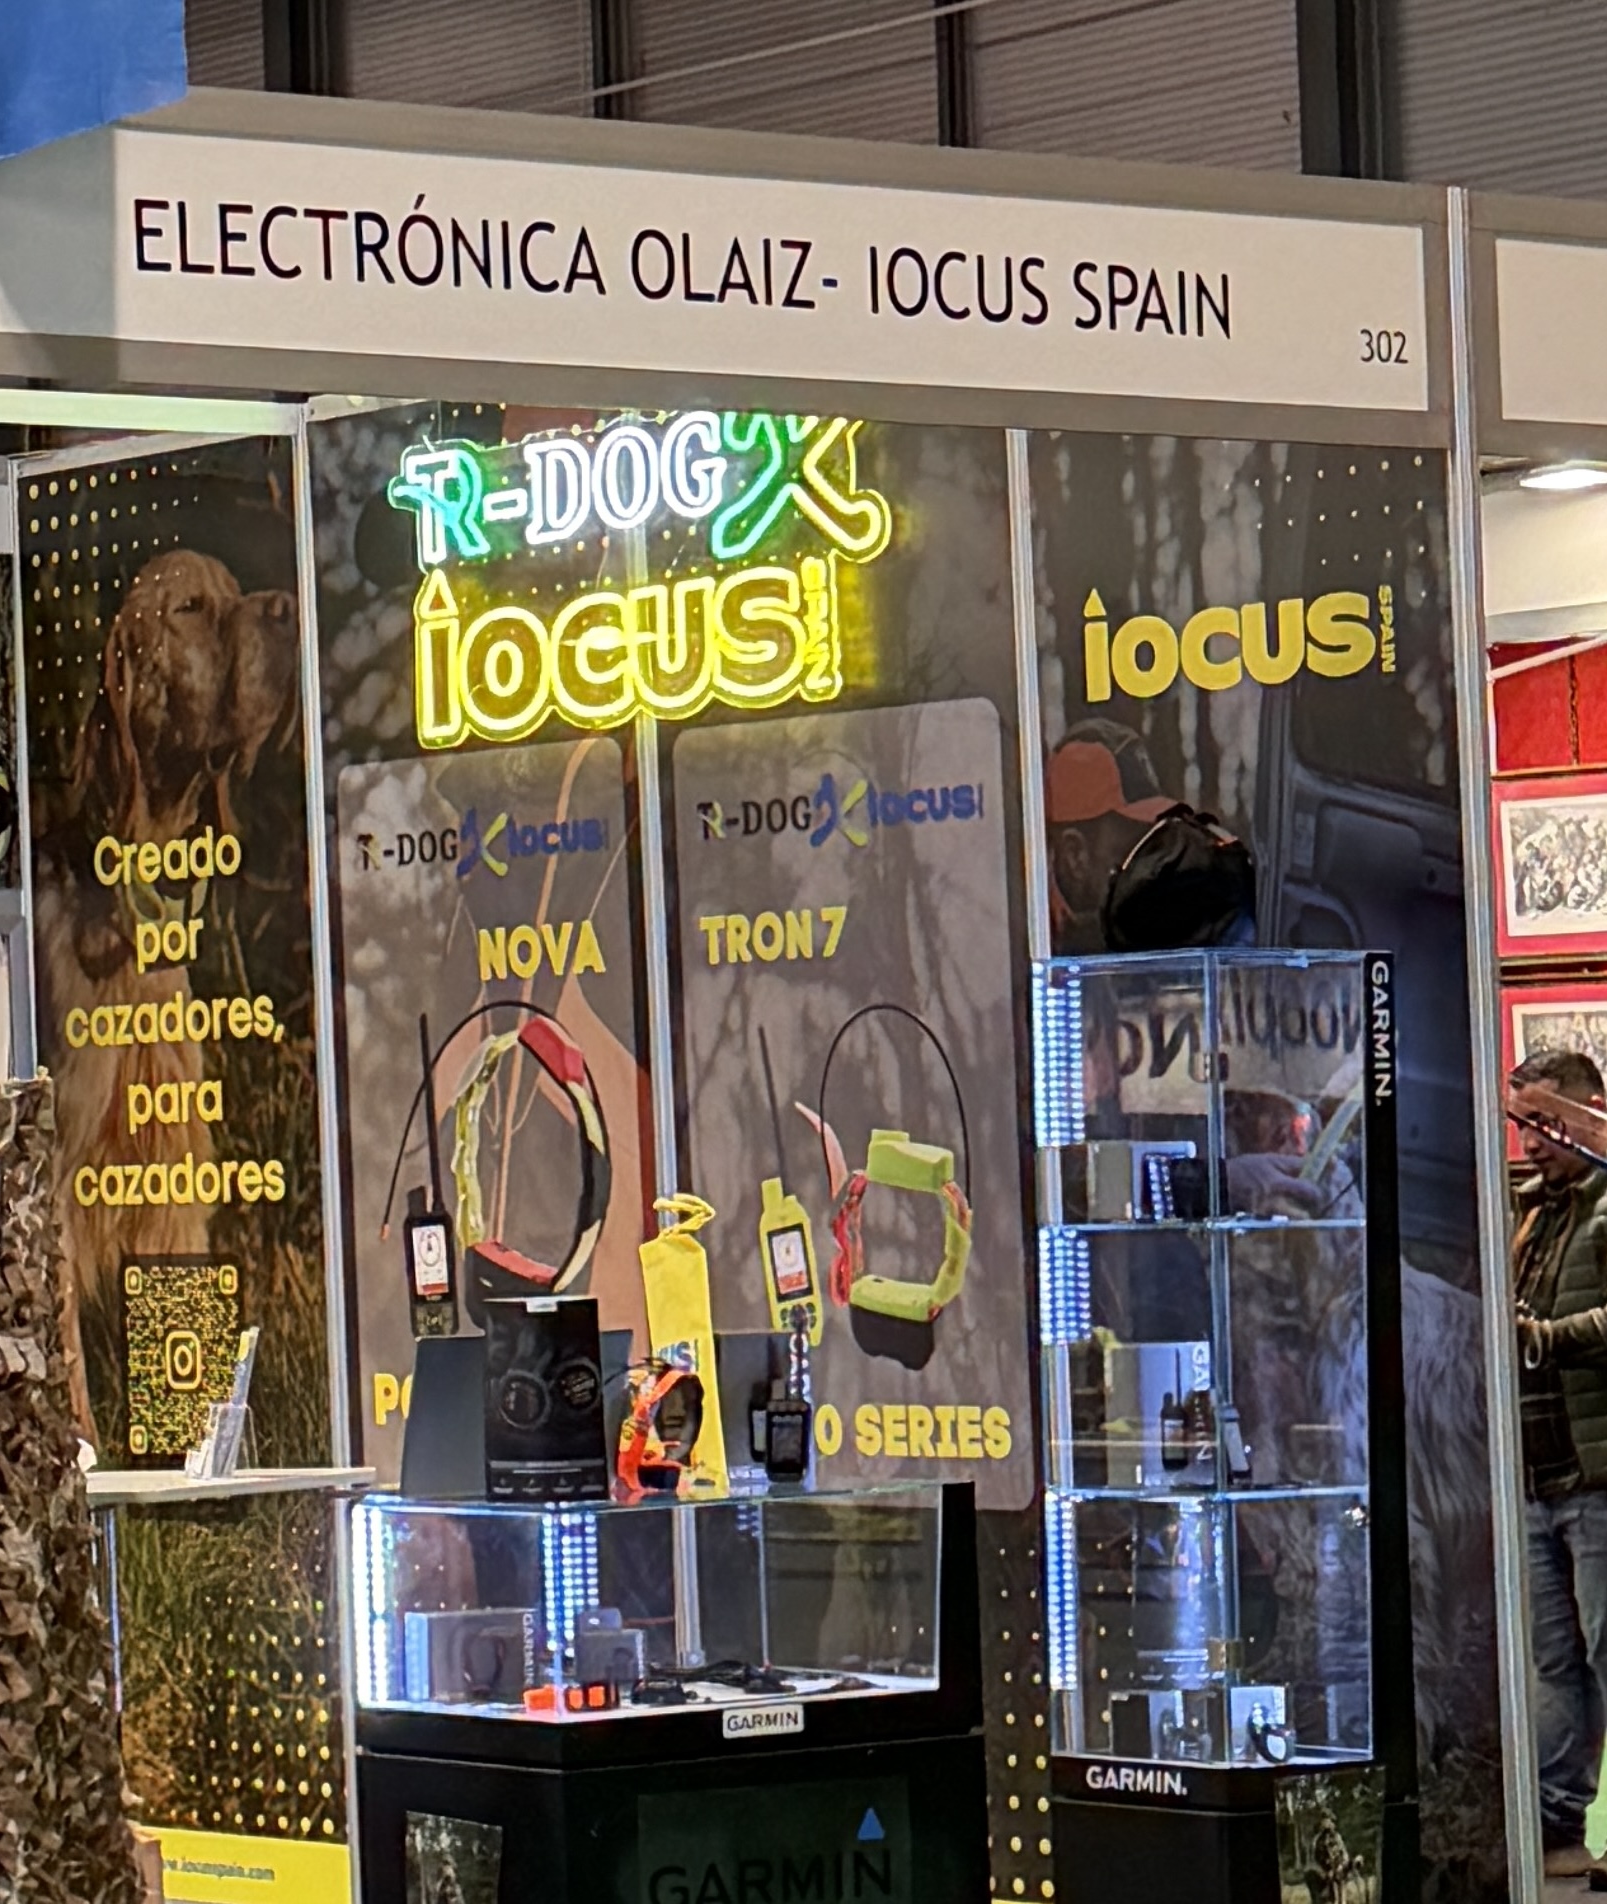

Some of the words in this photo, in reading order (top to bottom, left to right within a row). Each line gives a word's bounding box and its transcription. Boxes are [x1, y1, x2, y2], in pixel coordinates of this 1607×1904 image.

[134, 193, 607, 296] ELECTRÓNICA
[869, 246, 1049, 326] IOCUS
[1074, 261, 1232, 340] SPAIN
[1359, 328, 1409, 365] 302
[93, 825, 242, 886] Creado
[135, 918, 204, 975] por
[477, 919, 607, 982] NOVA
[699, 909, 814, 965] TRON
[820, 905, 848, 958] 7
[65, 990, 285, 1048] cazadores,
[127, 1079, 224, 1136] para
[74, 1151, 287, 1207] cazadores
[854, 1403, 1012, 1460] SERIES
[727, 1711, 799, 1732] GARMIN
